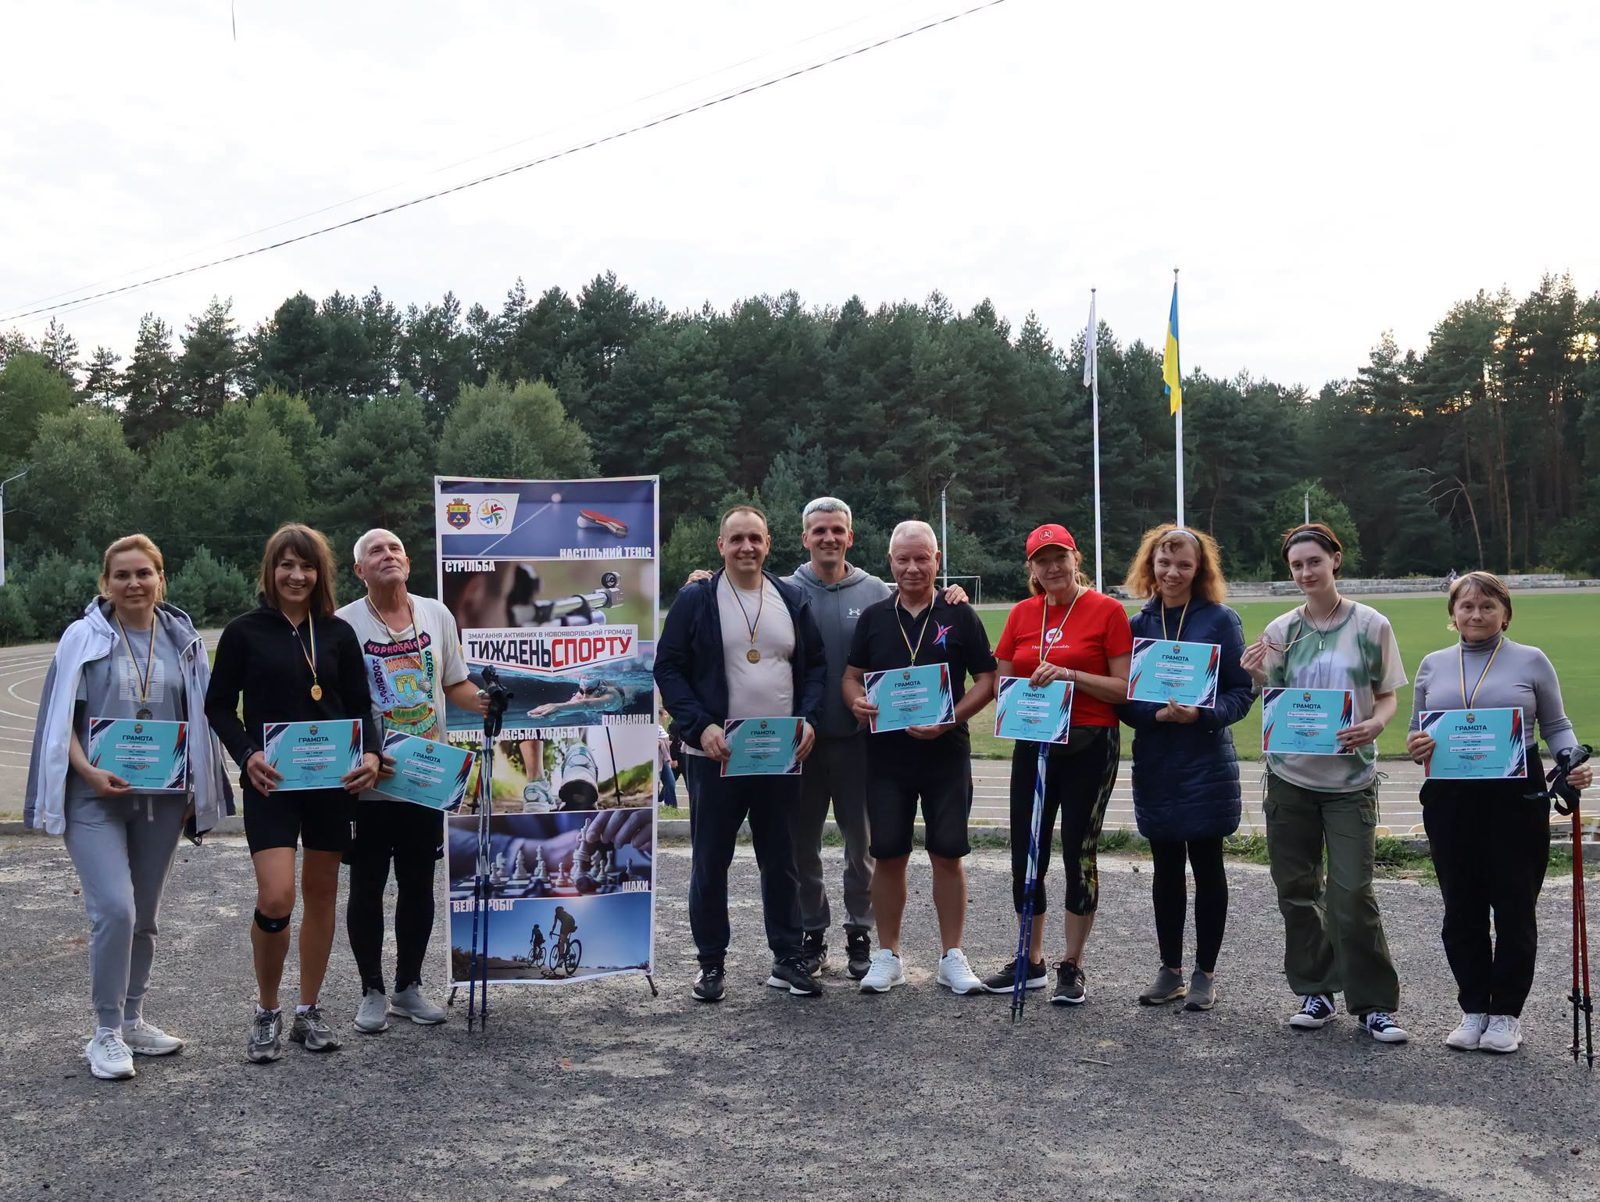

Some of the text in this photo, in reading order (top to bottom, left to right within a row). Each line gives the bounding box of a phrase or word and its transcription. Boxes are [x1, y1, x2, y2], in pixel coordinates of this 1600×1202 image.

[560, 546, 652, 559] НАСТІЛЬНИЙ ТЕНІС
[445, 560, 496, 572] СТРІЛЬБА
[544, 628, 602, 638] НОВОЯВОРІВСЬКІЙ
[1161, 654, 1189, 662] ГРАМОТА
[894, 680, 921, 688] ГРАМОТА
[602, 714, 651, 725] ПЛАВАННЯ
[539, 727, 579, 740] ХОДЬБА
[412, 751, 441, 763] ГРАМОТА
[622, 880, 649, 892] ШАХИ
[453, 899, 514, 912] ВЕЛПРОБІГ
